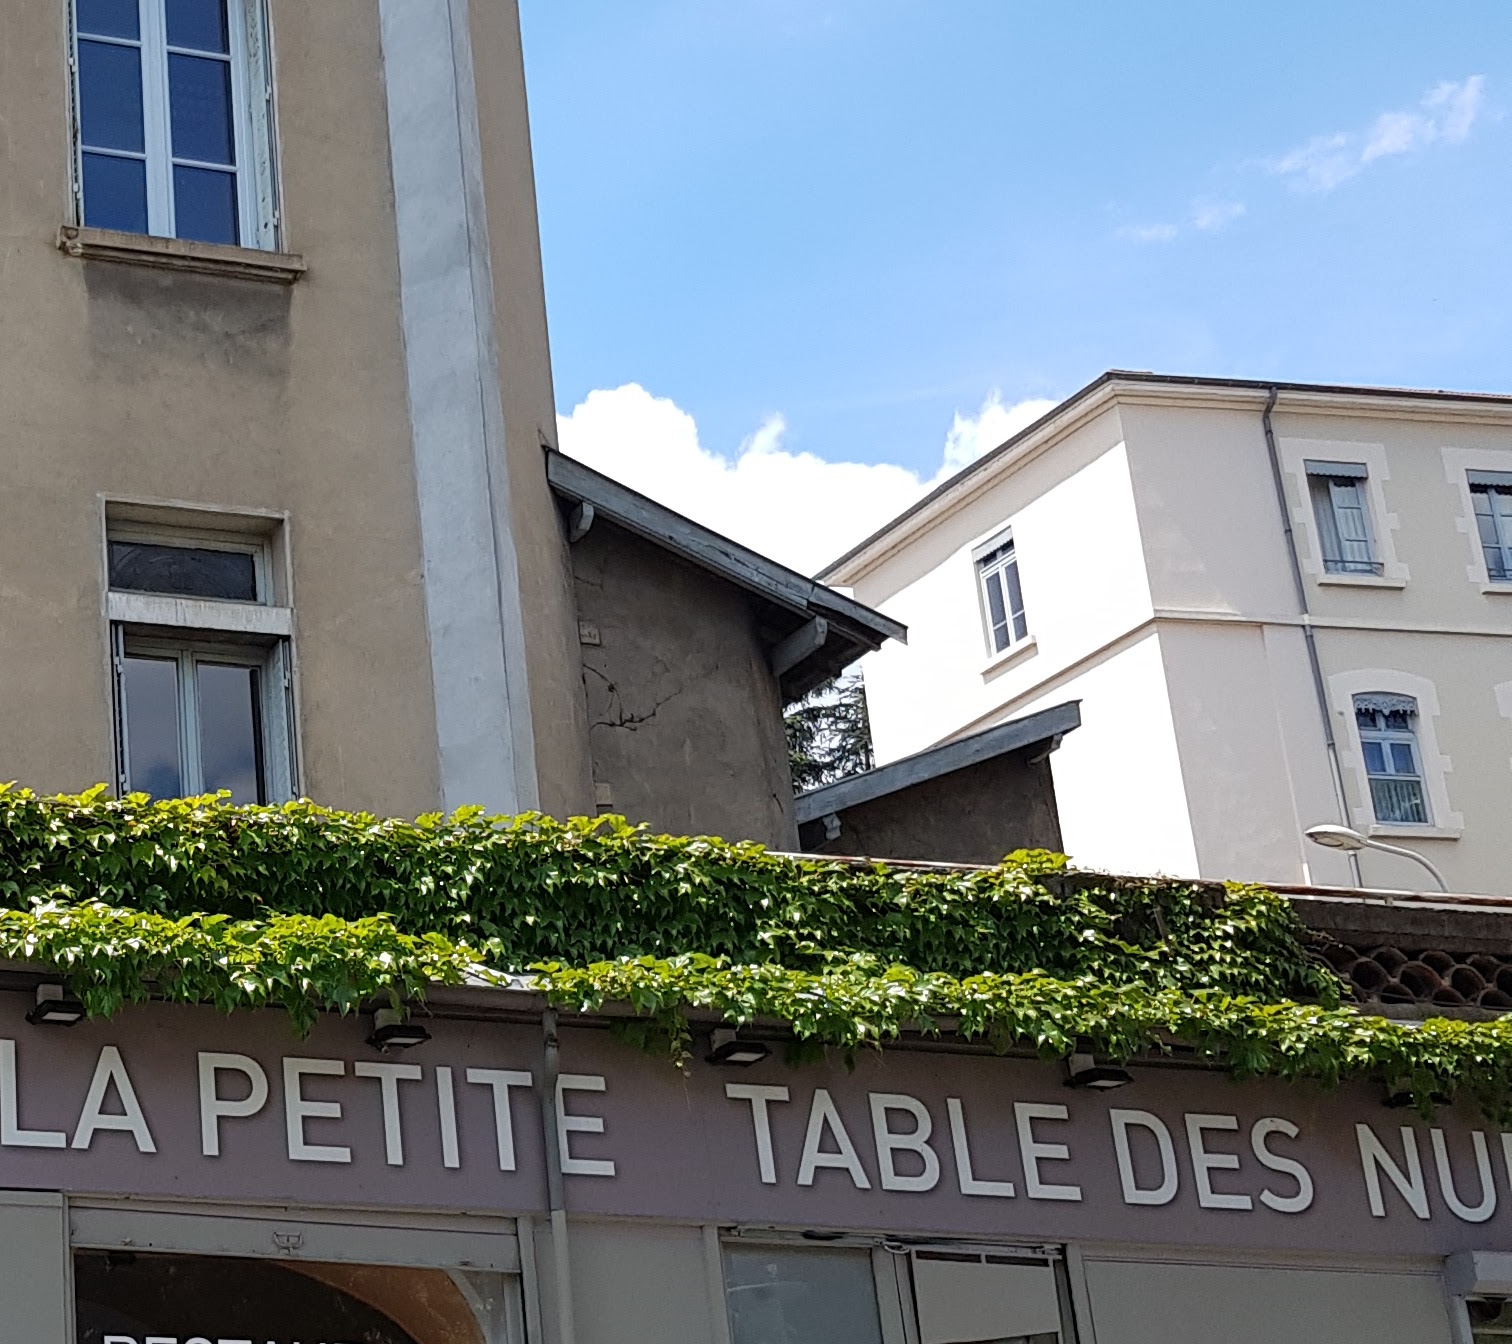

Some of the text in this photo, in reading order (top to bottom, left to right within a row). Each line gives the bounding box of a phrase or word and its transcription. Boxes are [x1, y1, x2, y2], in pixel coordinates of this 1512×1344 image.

[196, 1052, 616, 1177] PETITE
[725, 1083, 1082, 1202] TABLE
[1108, 1108, 1315, 1215] DES
